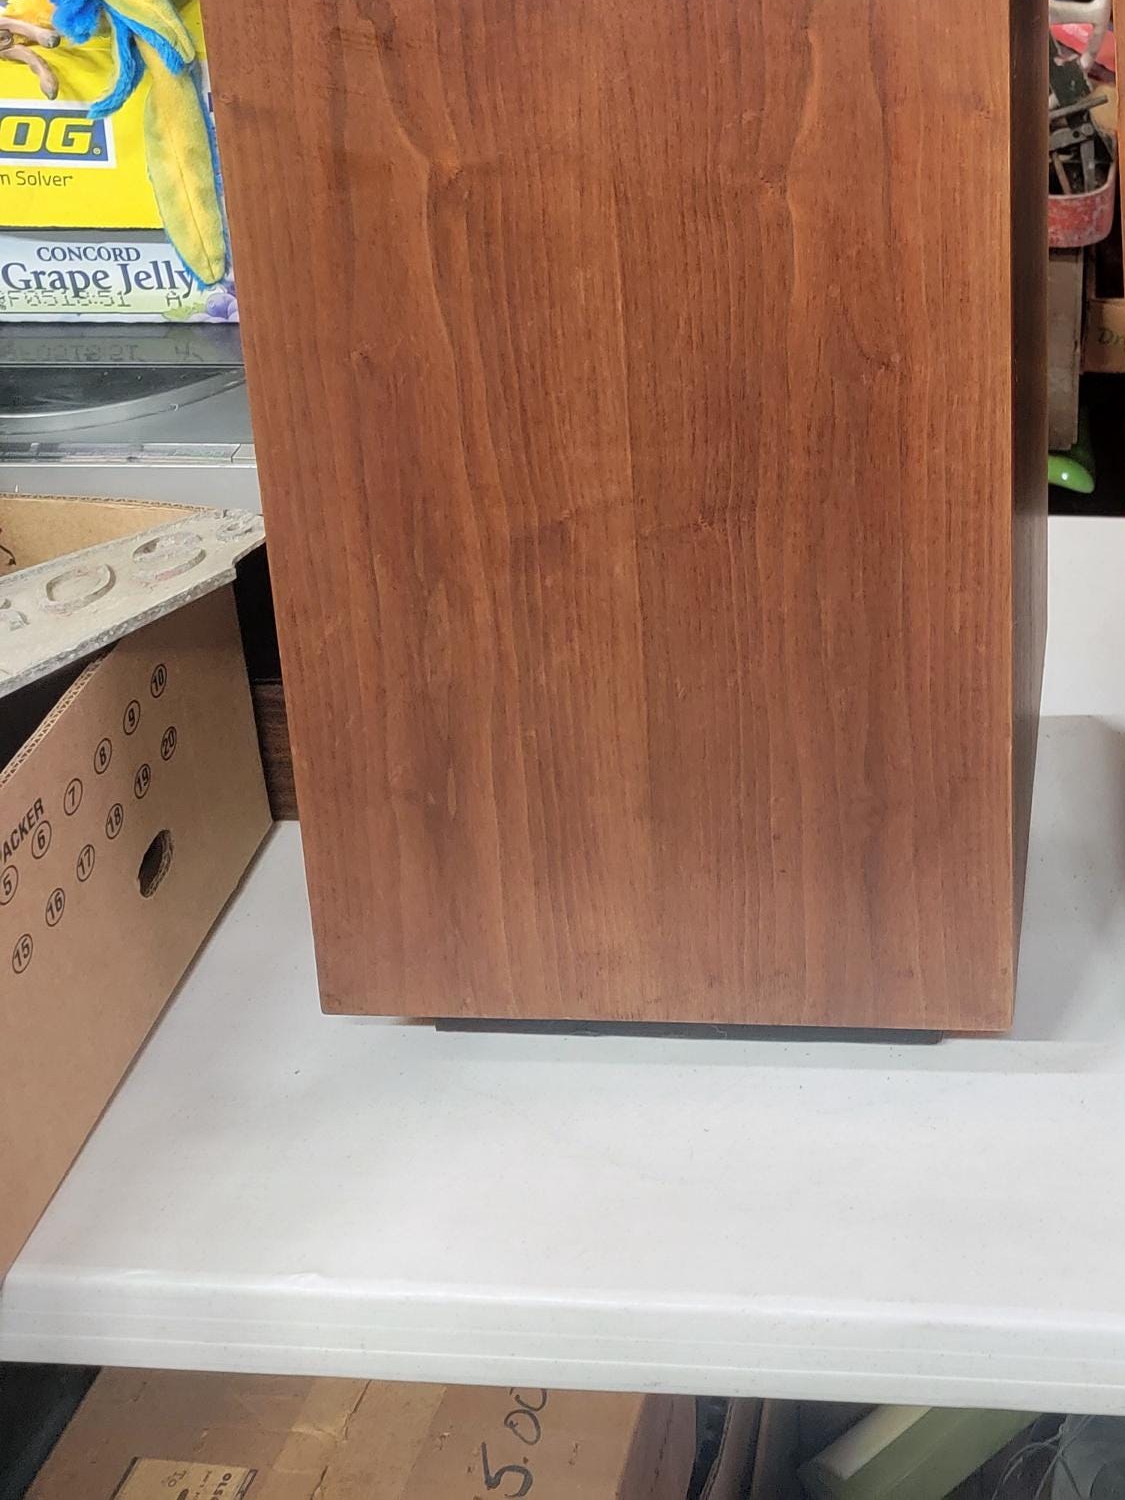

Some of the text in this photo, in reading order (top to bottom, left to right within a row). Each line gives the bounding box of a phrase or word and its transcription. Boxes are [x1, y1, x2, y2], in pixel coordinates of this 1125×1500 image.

[16, 170, 71, 187] Solver
[36, 246, 141, 262] CONCORD
[1, 260, 194, 299] Grape Jelly
[151, 669, 165, 691] 10
[127, 708, 136, 727] 9
[162, 733, 176, 755] 20
[99, 746, 107, 767] 8
[136, 771, 149, 791] 19
[69, 787, 77, 807] 7
[108, 811, 122, 833] 18
[37, 829, 46, 850] 6
[79, 851, 93, 875] 17
[2, 873, 13, 896] 5
[49, 895, 63, 919] 16
[14, 941, 31, 967] 15
